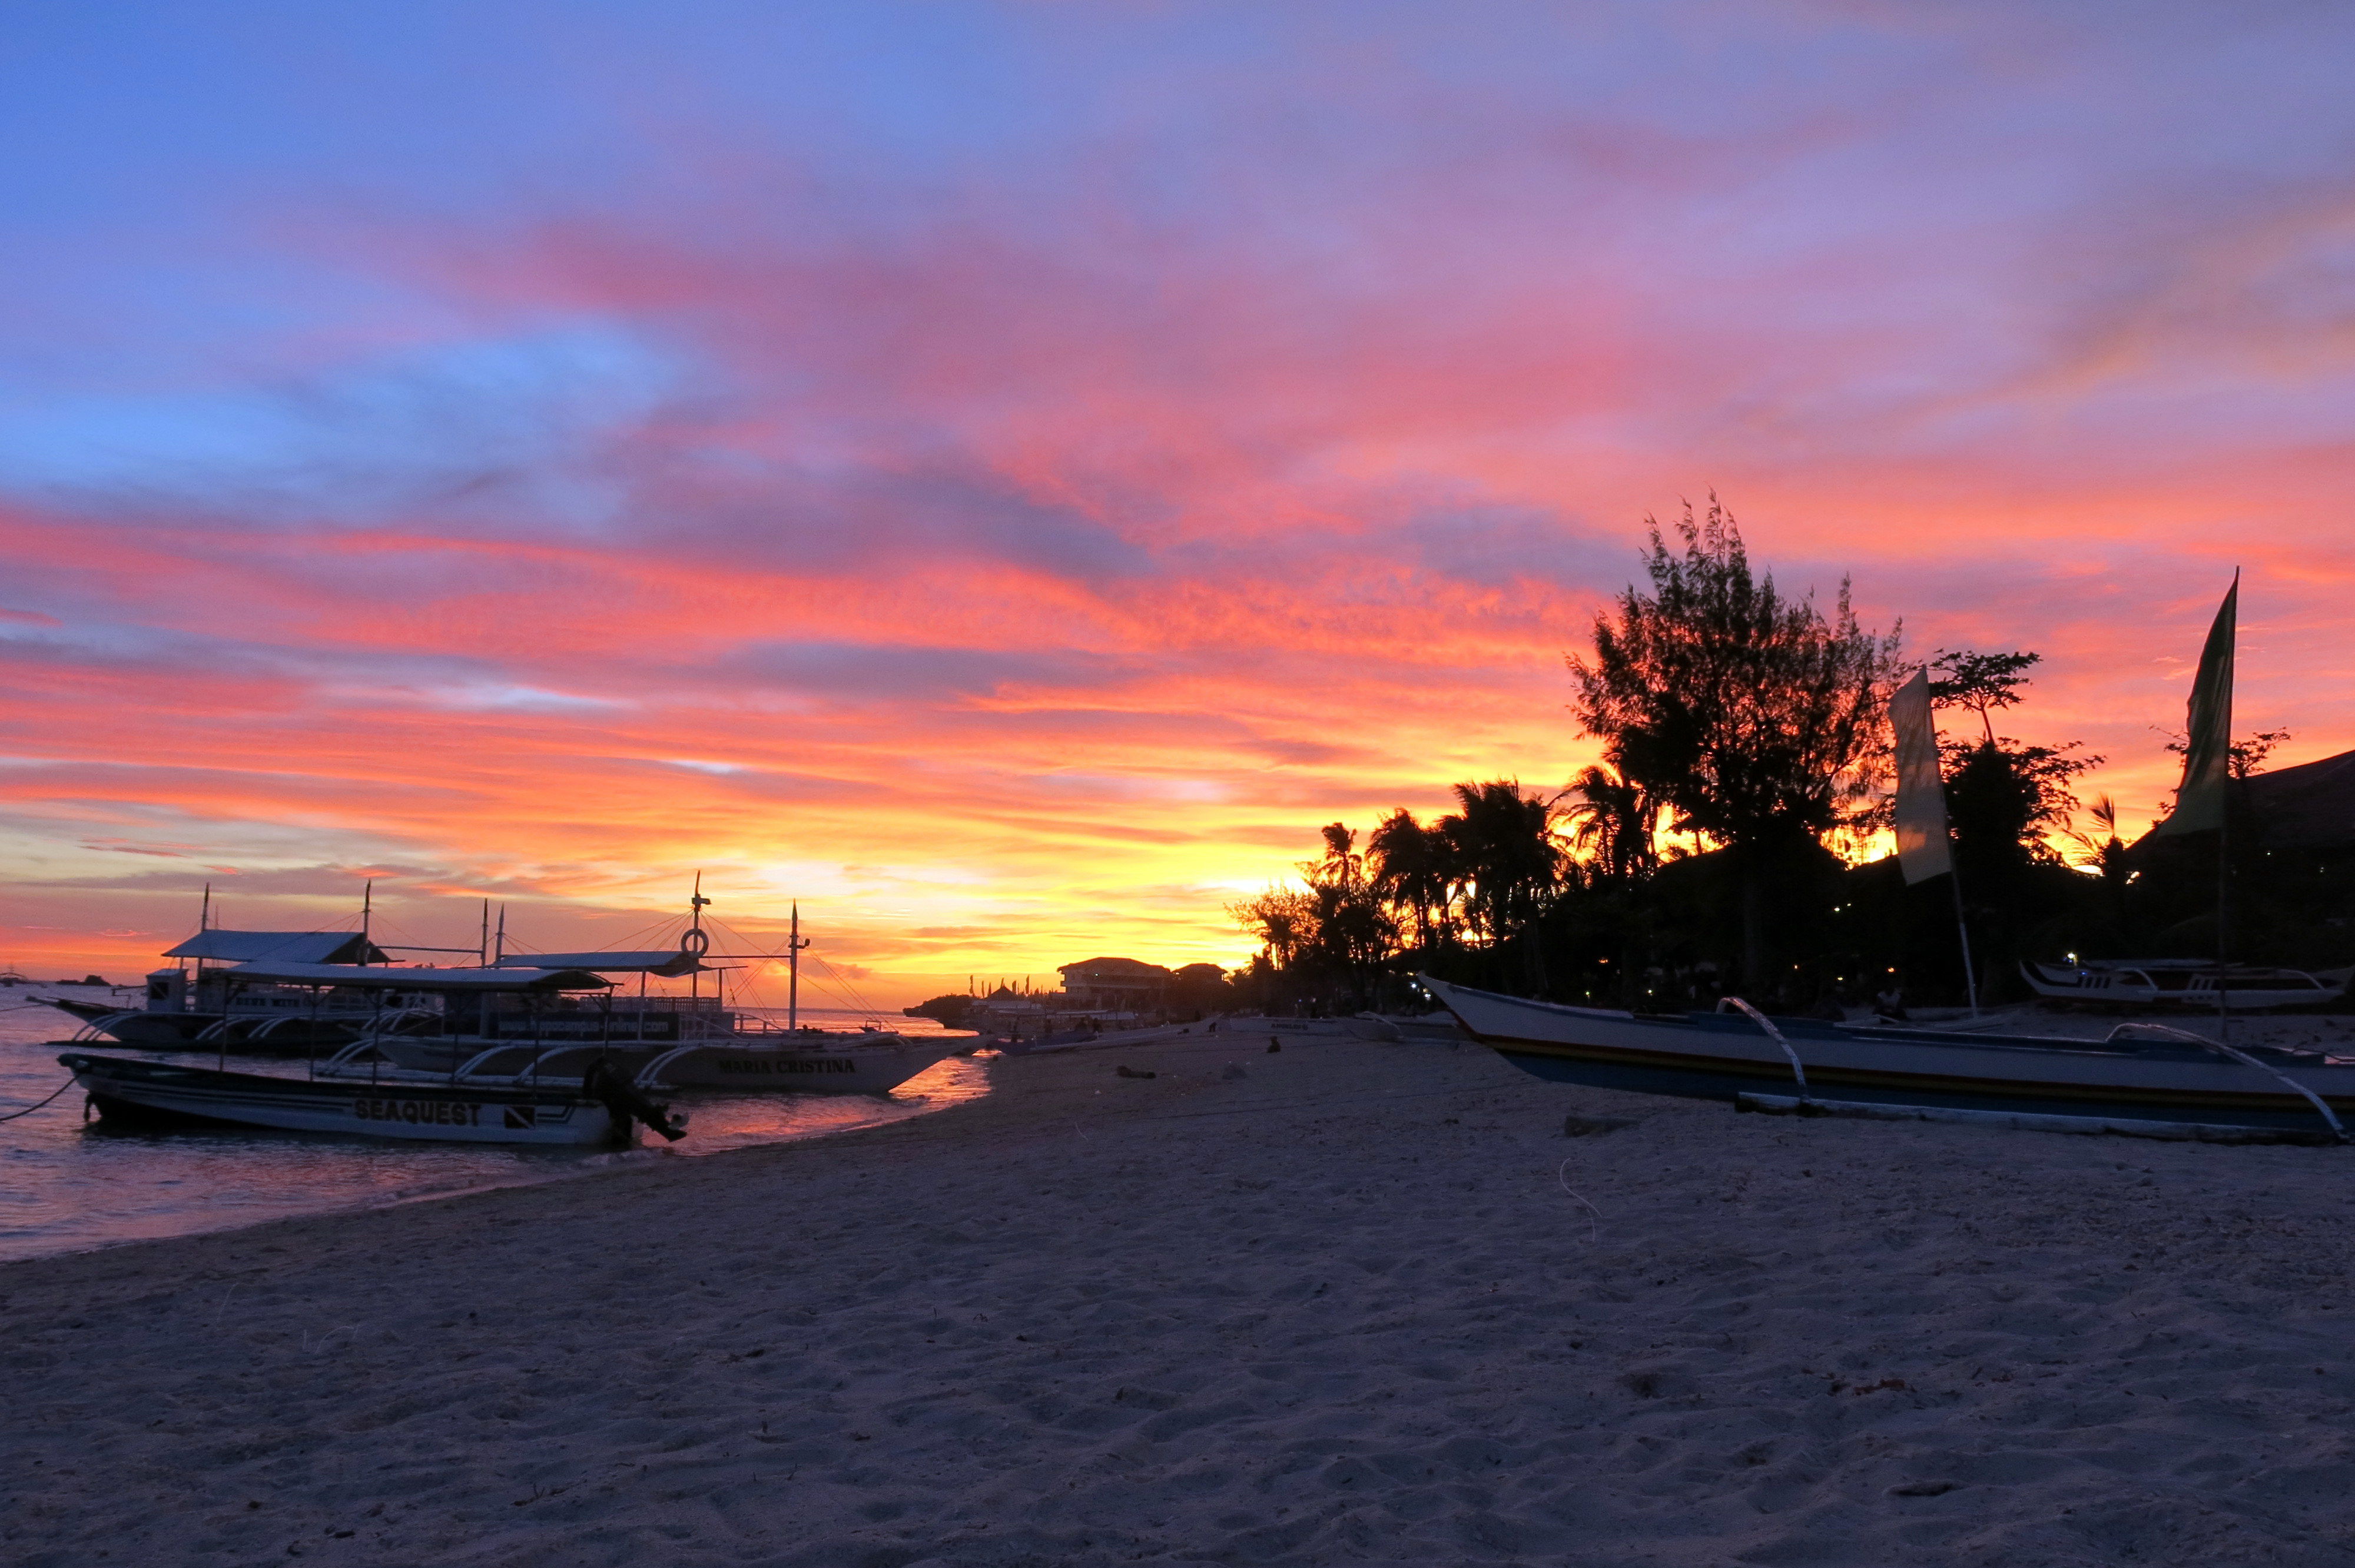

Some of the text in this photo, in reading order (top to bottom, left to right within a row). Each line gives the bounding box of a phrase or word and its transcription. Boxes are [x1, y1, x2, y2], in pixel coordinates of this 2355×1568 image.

[718, 1059, 856, 1074] MARIA CRISTINA
[355, 1099, 480, 1126] SEAQUEST
